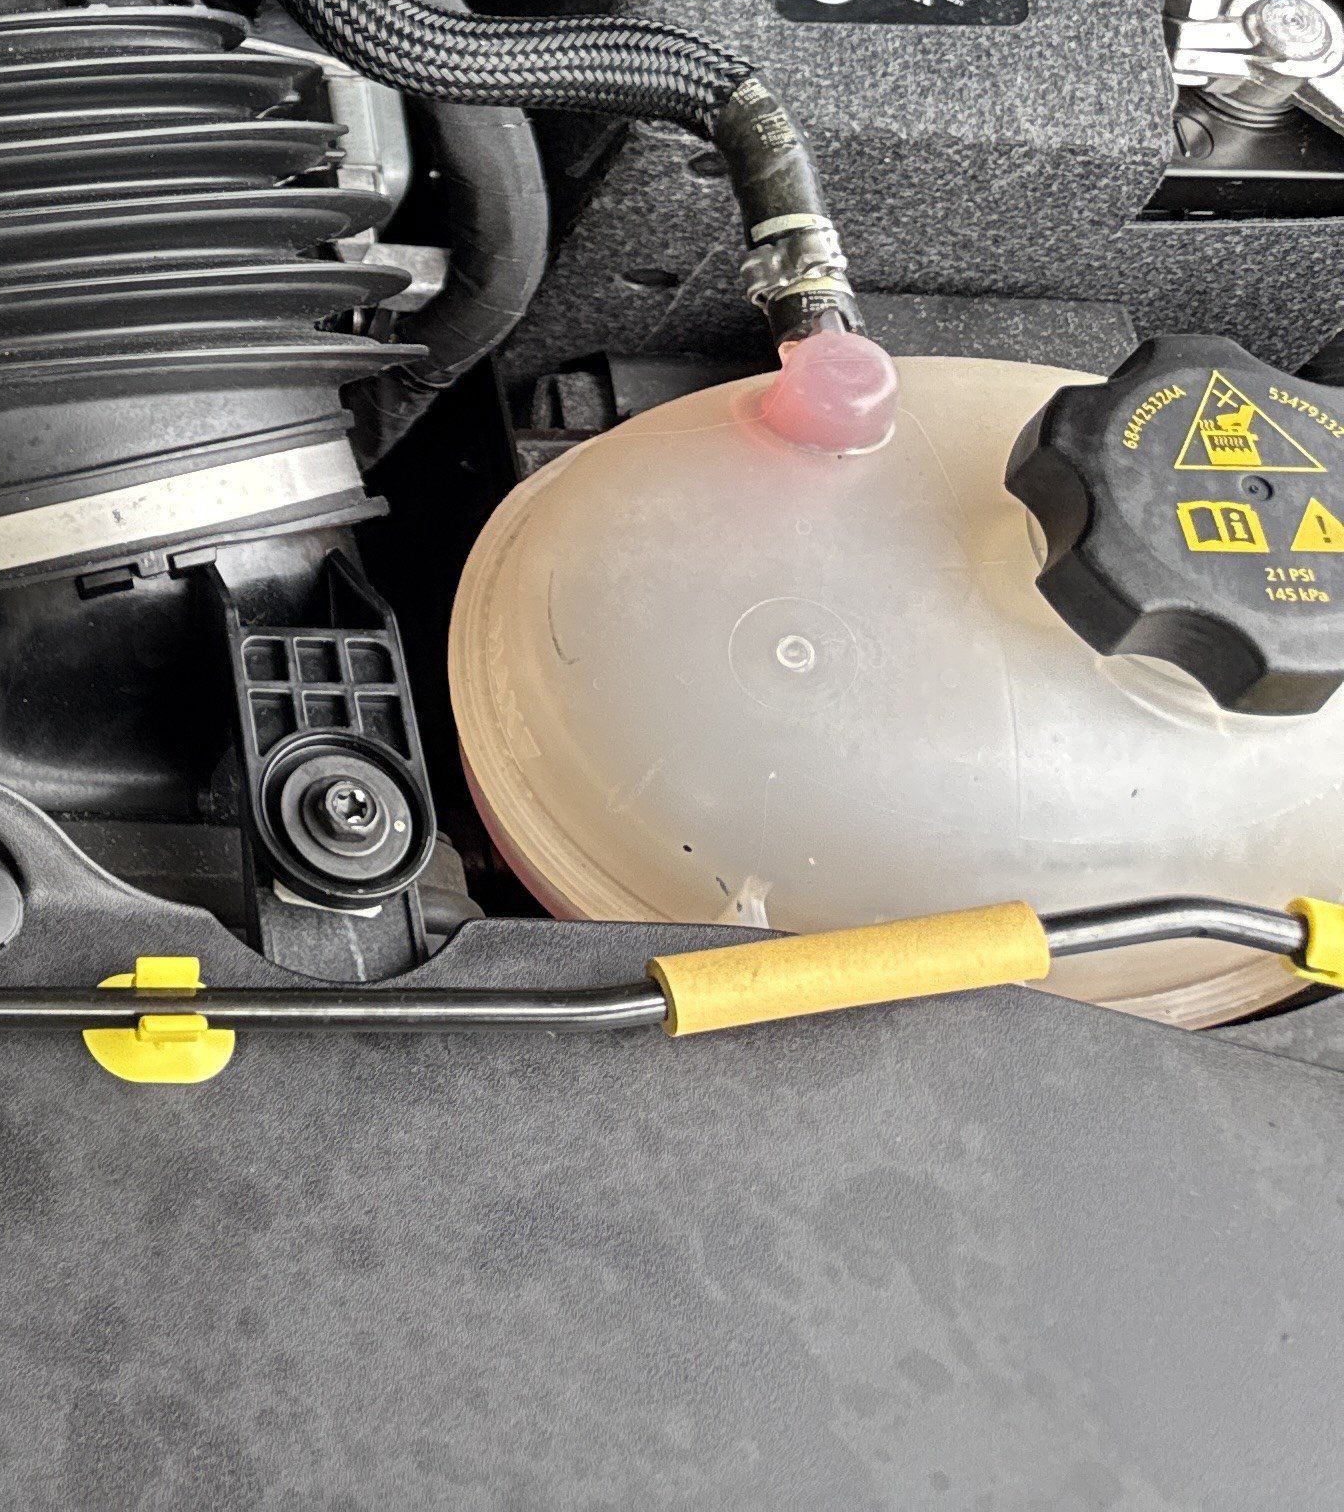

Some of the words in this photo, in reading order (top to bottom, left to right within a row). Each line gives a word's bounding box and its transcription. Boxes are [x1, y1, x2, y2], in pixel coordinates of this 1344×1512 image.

[1123, 385, 1187, 449] 68442532AA
[1264, 567, 1286, 582] 21
[1289, 568, 1316, 582] PSI
[1265, 588, 1297, 602] 145
[1298, 587, 1330, 603] kPa
